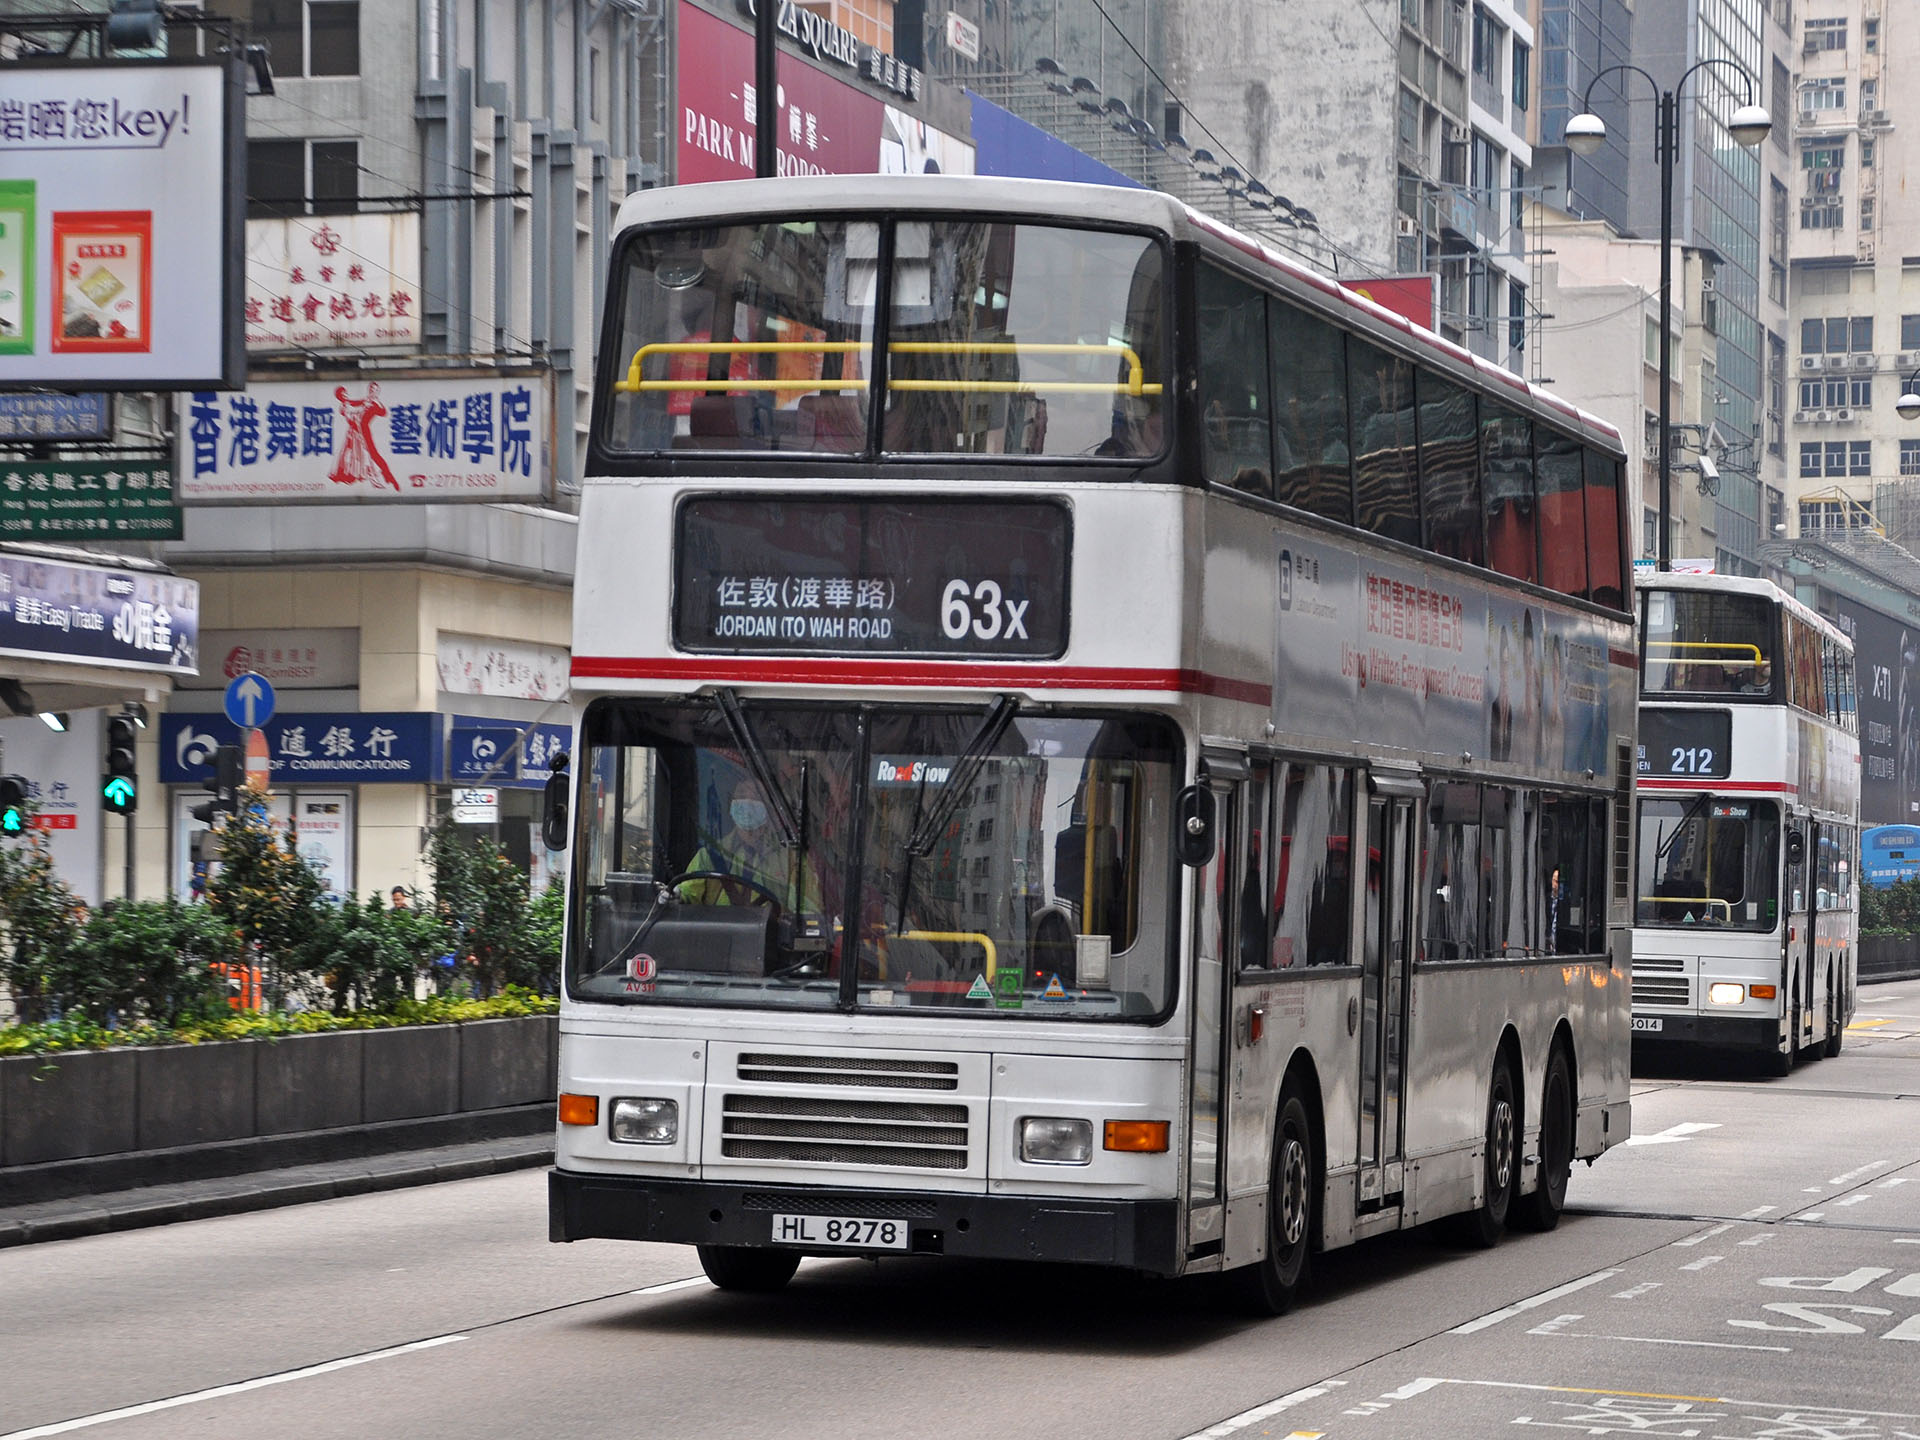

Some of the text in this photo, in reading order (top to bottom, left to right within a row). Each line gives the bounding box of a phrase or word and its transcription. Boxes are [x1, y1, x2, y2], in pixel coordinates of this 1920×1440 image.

[802, 8, 858, 68] SQUARE
[685, 106, 735, 162] PARK
[190, 385, 532, 479] 香港舞蹈 藝術學院
[717, 576, 895, 610] 佐敦(渡華路)
[715, 615, 892, 639] JORDAN (TO WAH ROAD
[1341, 641, 1367, 688] Using
[290, 759, 411, 770] COMMUNICATIONS
[1671, 747, 1713, 773] 212
[636, 959, 649, 976] U
[782, 1217, 897, 1244] HL 8278
